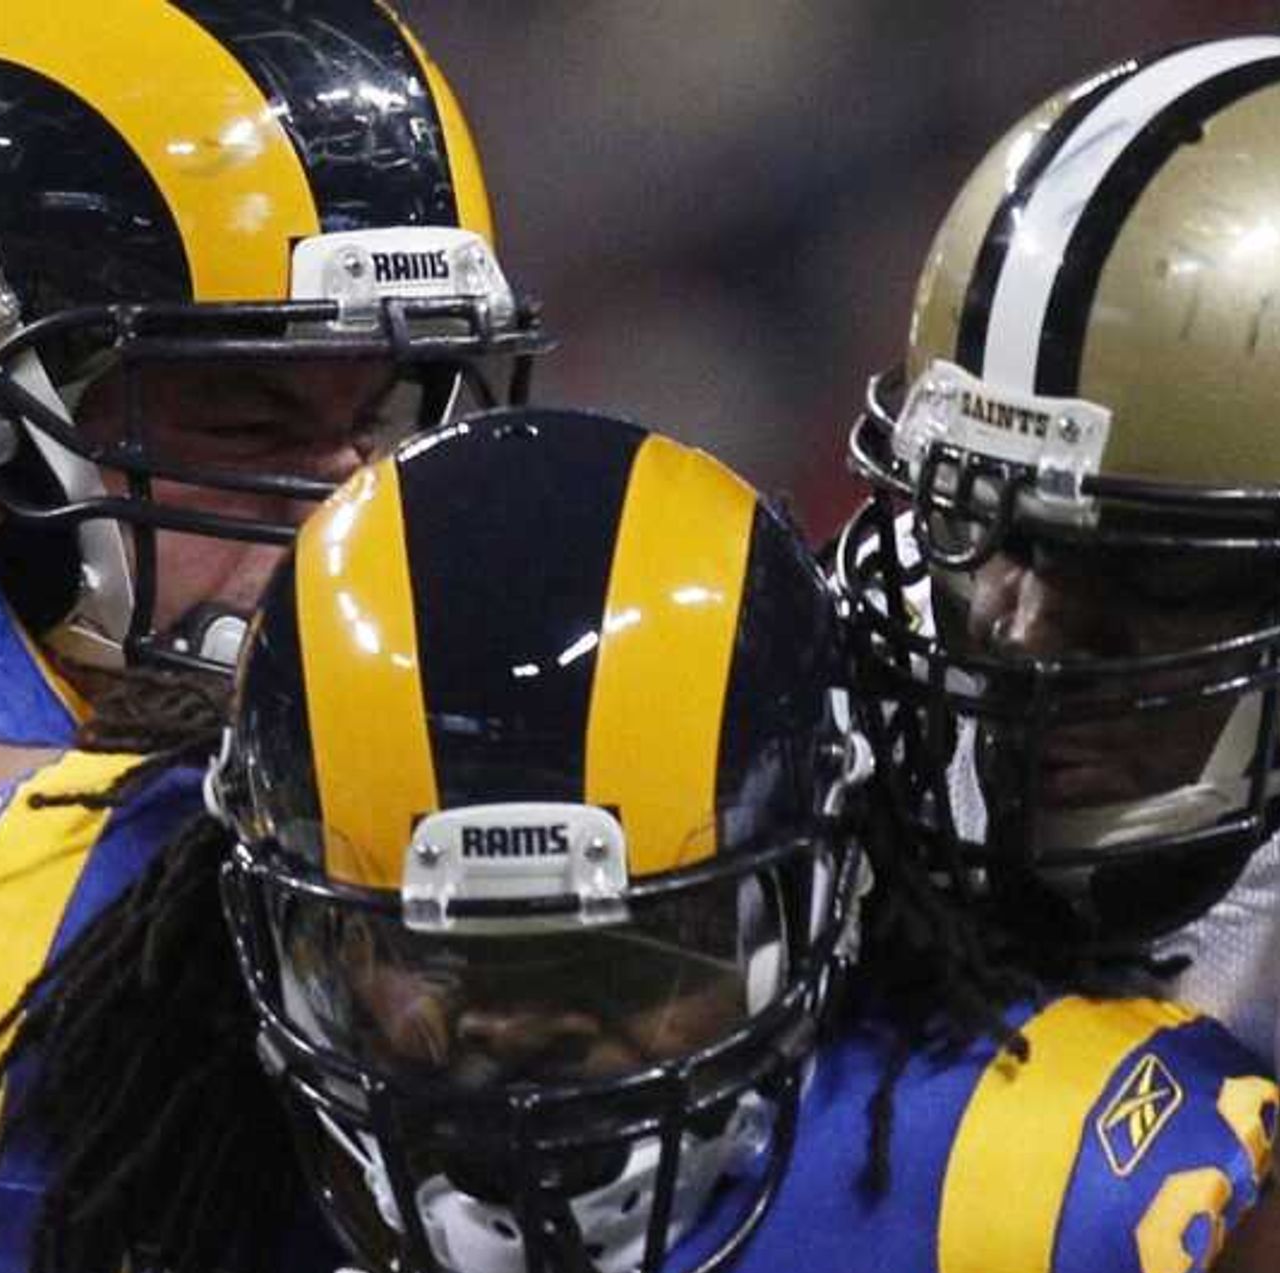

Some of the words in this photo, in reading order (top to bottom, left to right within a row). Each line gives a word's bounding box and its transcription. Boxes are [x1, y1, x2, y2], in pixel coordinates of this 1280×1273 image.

[372, 250, 450, 282] RAMS
[960, 392, 1051, 438] SAINTS
[461, 824, 568, 858] RAMS
